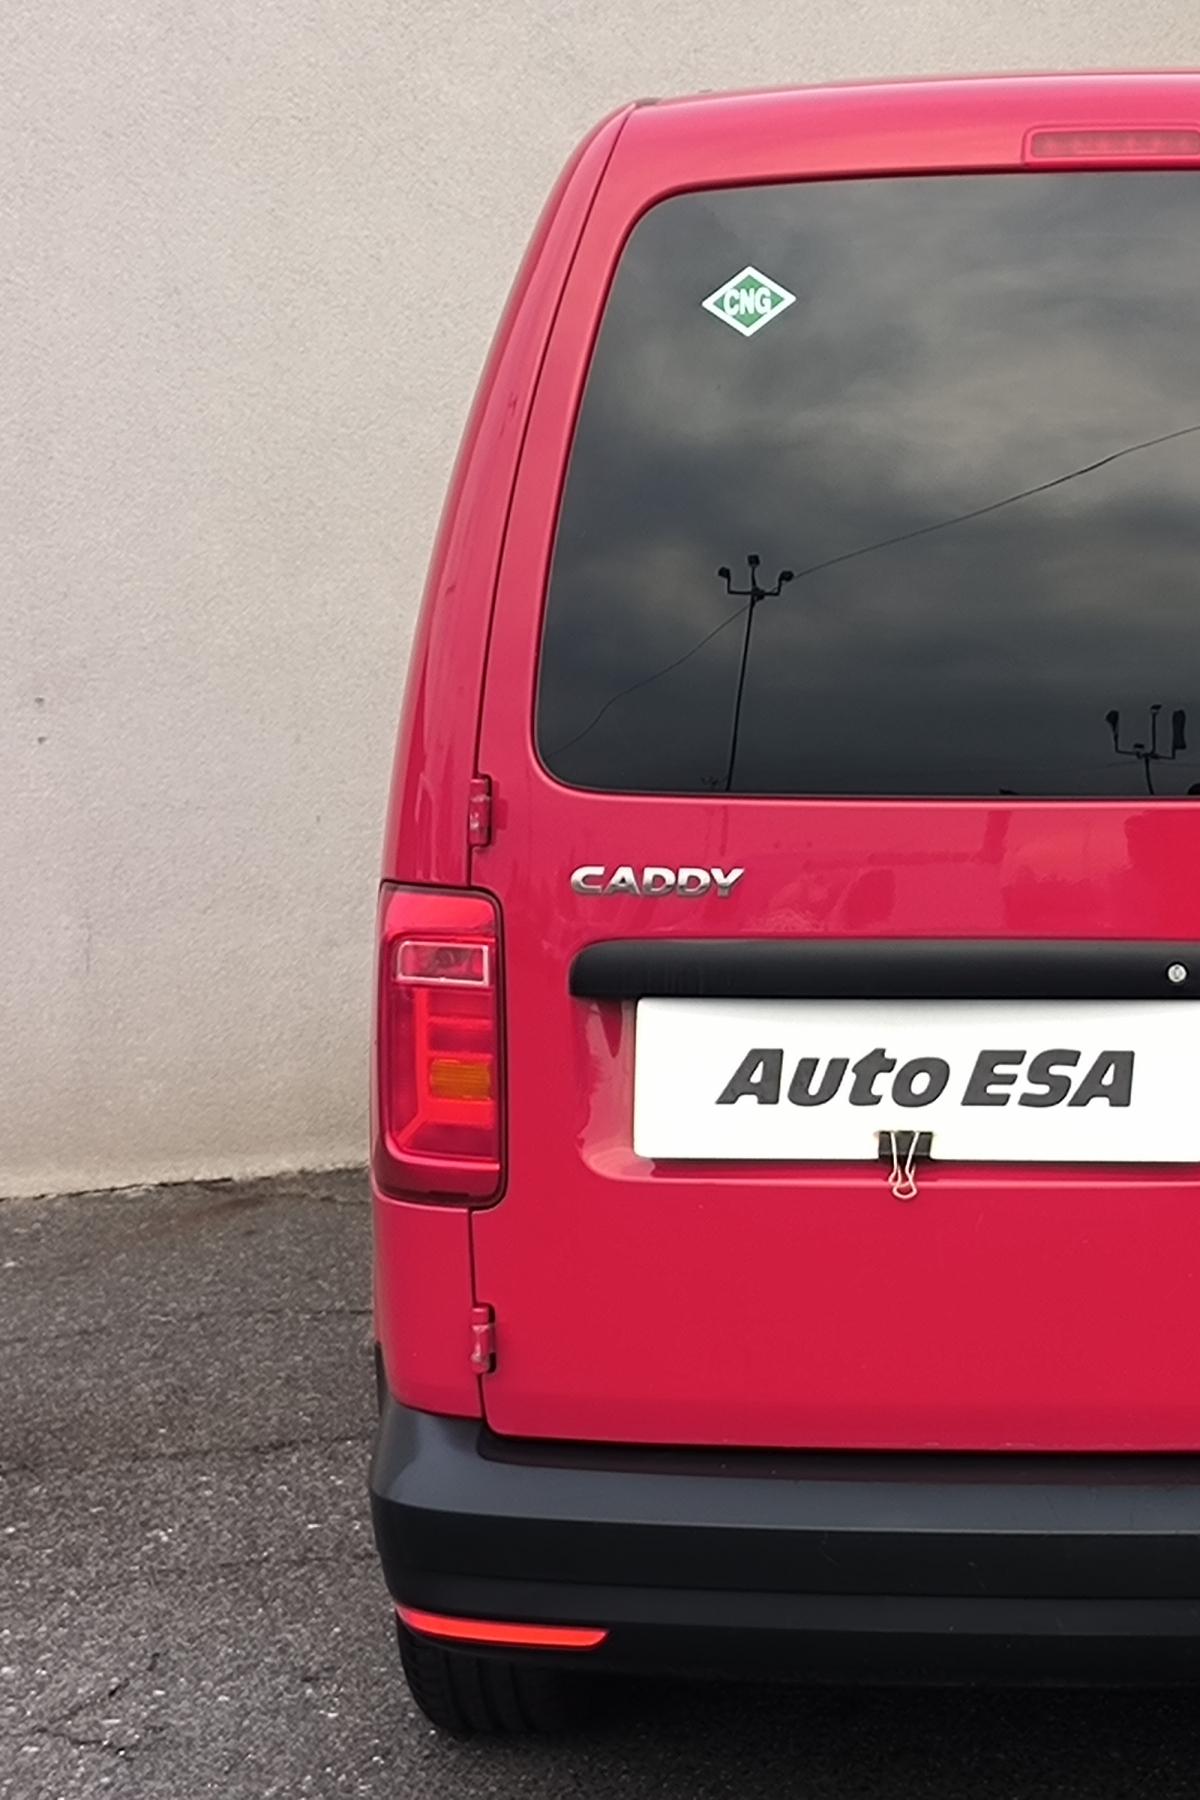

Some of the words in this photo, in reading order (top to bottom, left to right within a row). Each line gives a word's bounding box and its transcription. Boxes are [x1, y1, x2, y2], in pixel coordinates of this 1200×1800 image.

[723, 287, 772, 315] CNG
[570, 865, 745, 897] CADDY
[715, 1047, 950, 1108] Auto
[961, 1049, 1135, 1107] ESA
